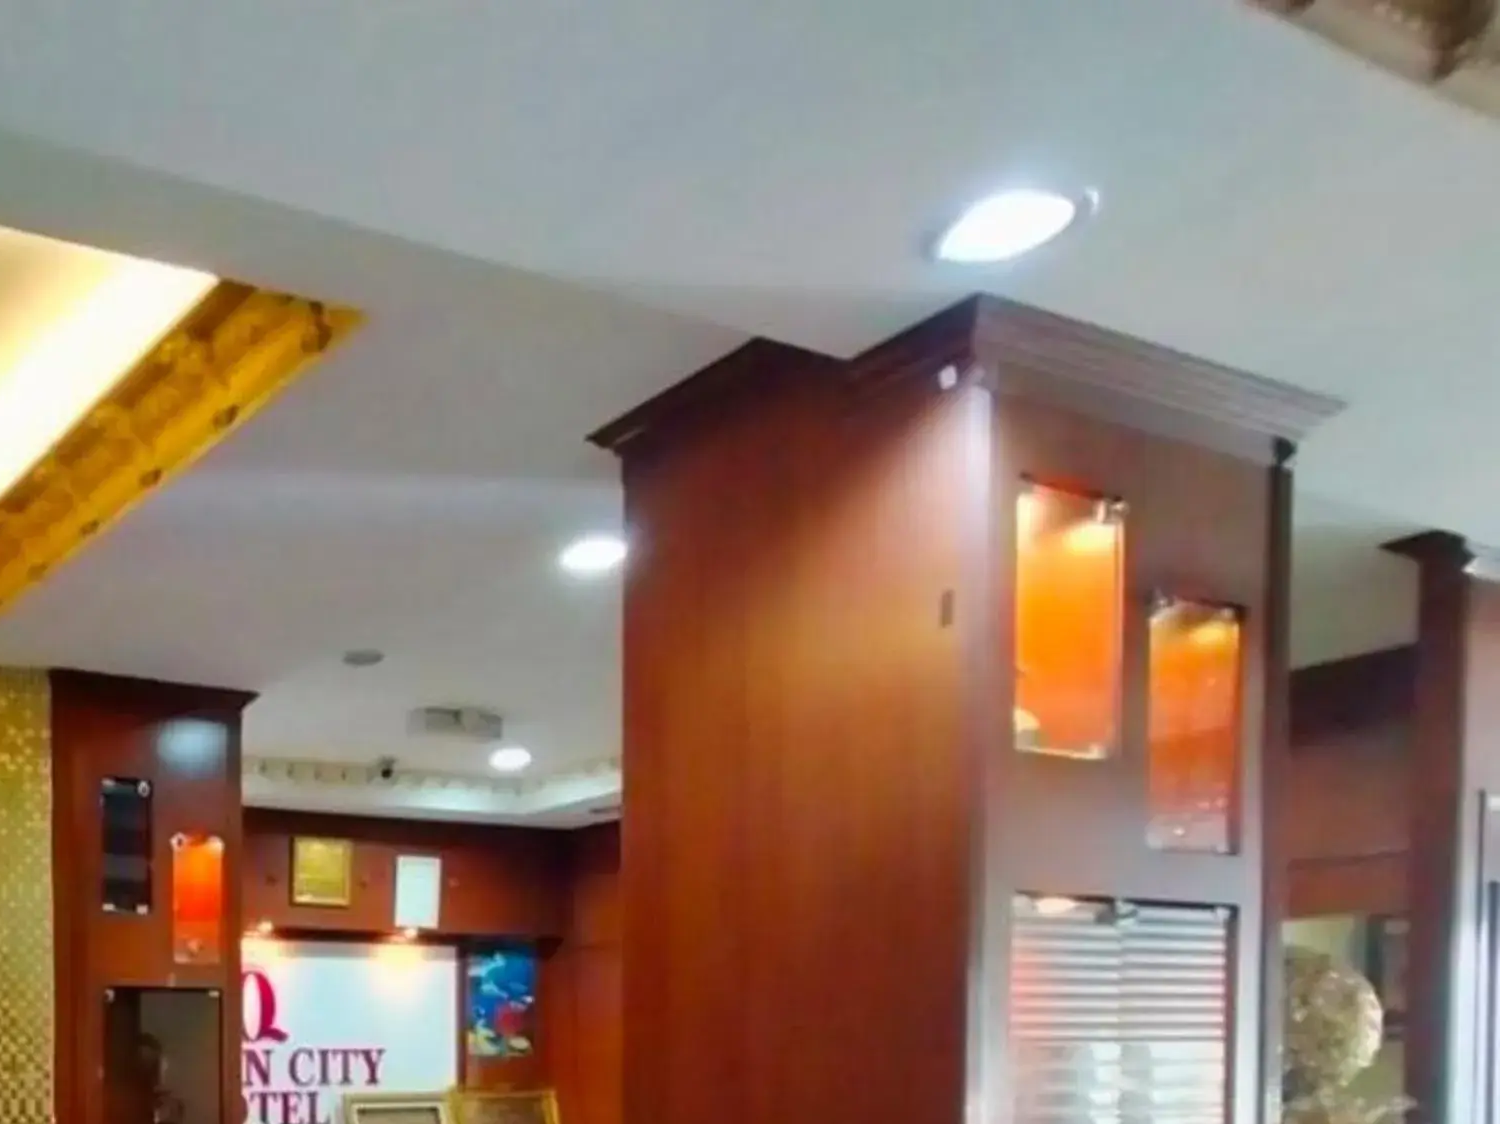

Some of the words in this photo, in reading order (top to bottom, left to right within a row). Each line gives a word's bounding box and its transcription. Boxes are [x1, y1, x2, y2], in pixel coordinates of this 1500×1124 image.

[241, 970, 288, 1042] Q
[241, 1048, 274, 1087] N
[288, 1047, 386, 1087] CITY
